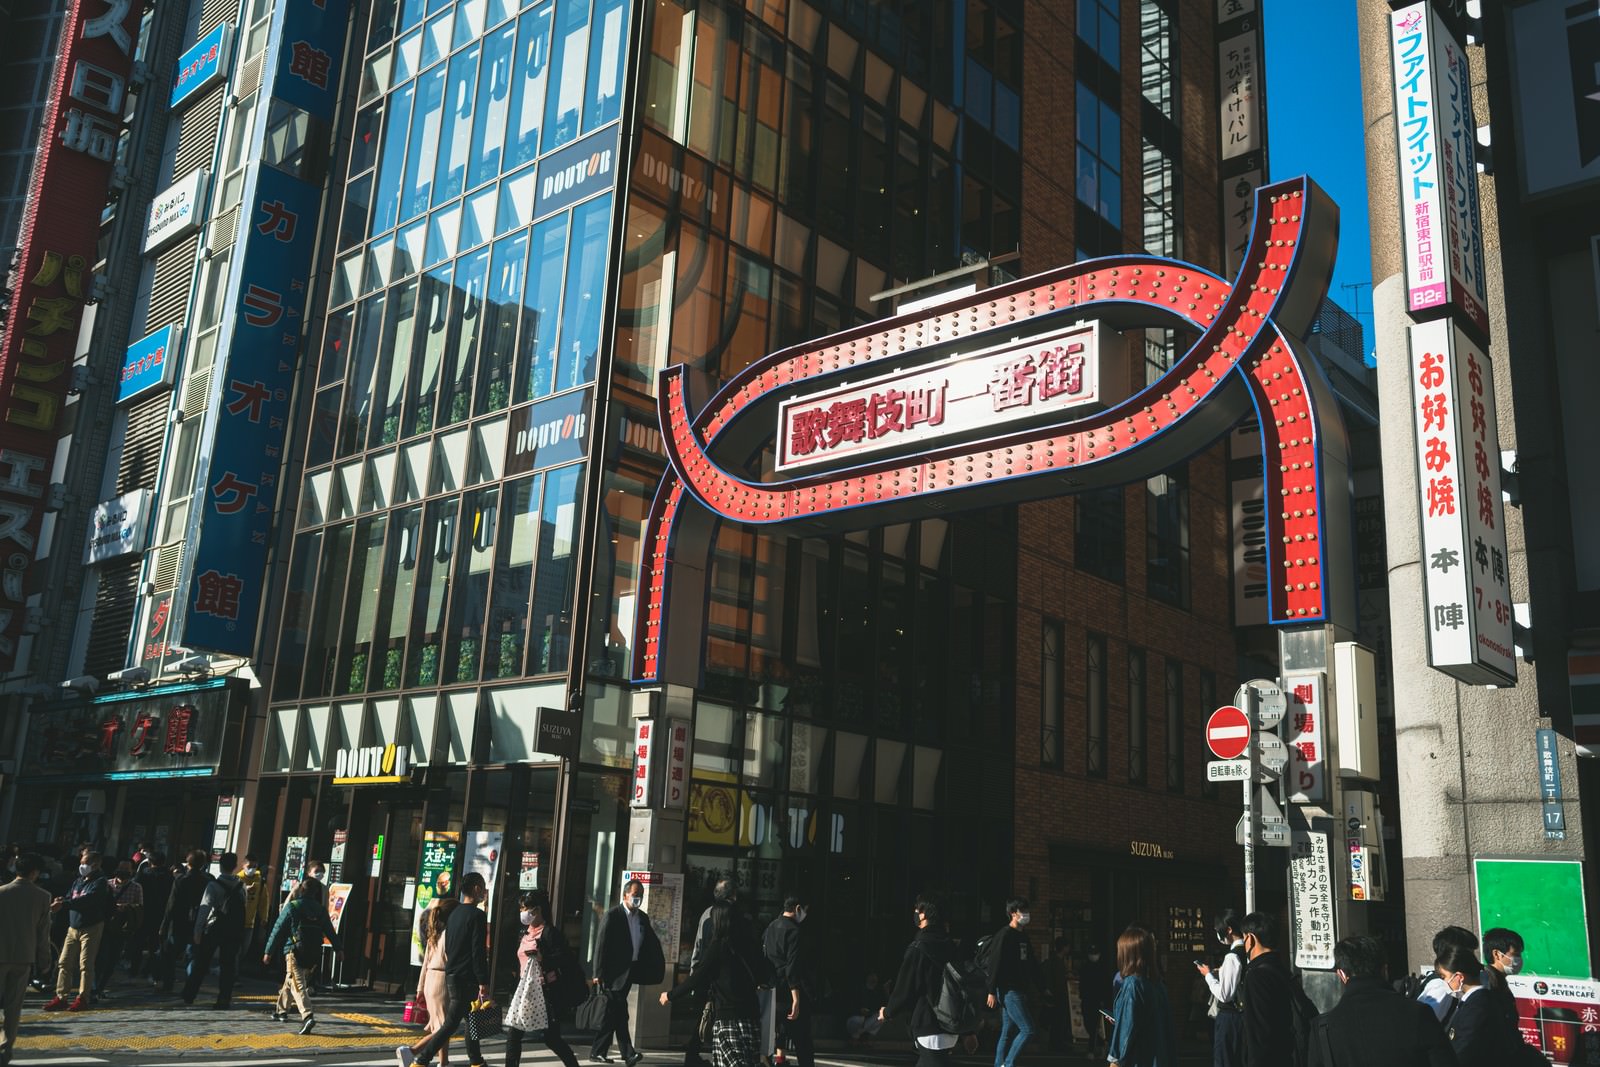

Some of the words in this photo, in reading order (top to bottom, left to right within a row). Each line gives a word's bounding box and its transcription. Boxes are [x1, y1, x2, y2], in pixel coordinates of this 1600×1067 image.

[1226, 49, 1248, 145] ちびすけバル
[1397, 32, 1434, 200] ファイトフィット
[543, 149, 611, 200] DOUTOR
[643, 152, 717, 213] DOUTOR
[1414, 201, 1434, 281] 新宿東口駅前
[1412, 287, 1443, 305] B2F
[193, 200, 298, 621] カラオケ館
[515, 413, 586, 456] DOUTOR
[790, 342, 1085, 457] 歌舞伎町一番街
[1420, 352, 1456, 518] お好み焼
[1467, 353, 1495, 530] お好み焼
[1430, 547, 1465, 632] 本陣
[1474, 535, 1505, 587] 本陣
[335, 743, 407, 779] DOUTOR
[542, 723, 571, 737] SUZUYA
[635, 725, 650, 799] 劇場通り
[671, 727, 686, 800] 劇場通り
[1294, 683, 1316, 790] 劇場通り
[1130, 841, 1162, 858] SUZUYA
[1545, 812, 1560, 824] 17
[1547, 831, 1564, 839] 17-2
[425, 848, 455, 863] 大豆ミート
[1305, 842, 1322, 945] 防犯カメラ作動中
[1315, 836, 1332, 950] みなさまの安全を守ります
[1551, 988, 1575, 997] SEVEN
[1575, 989, 1596, 999] CAFÉ
